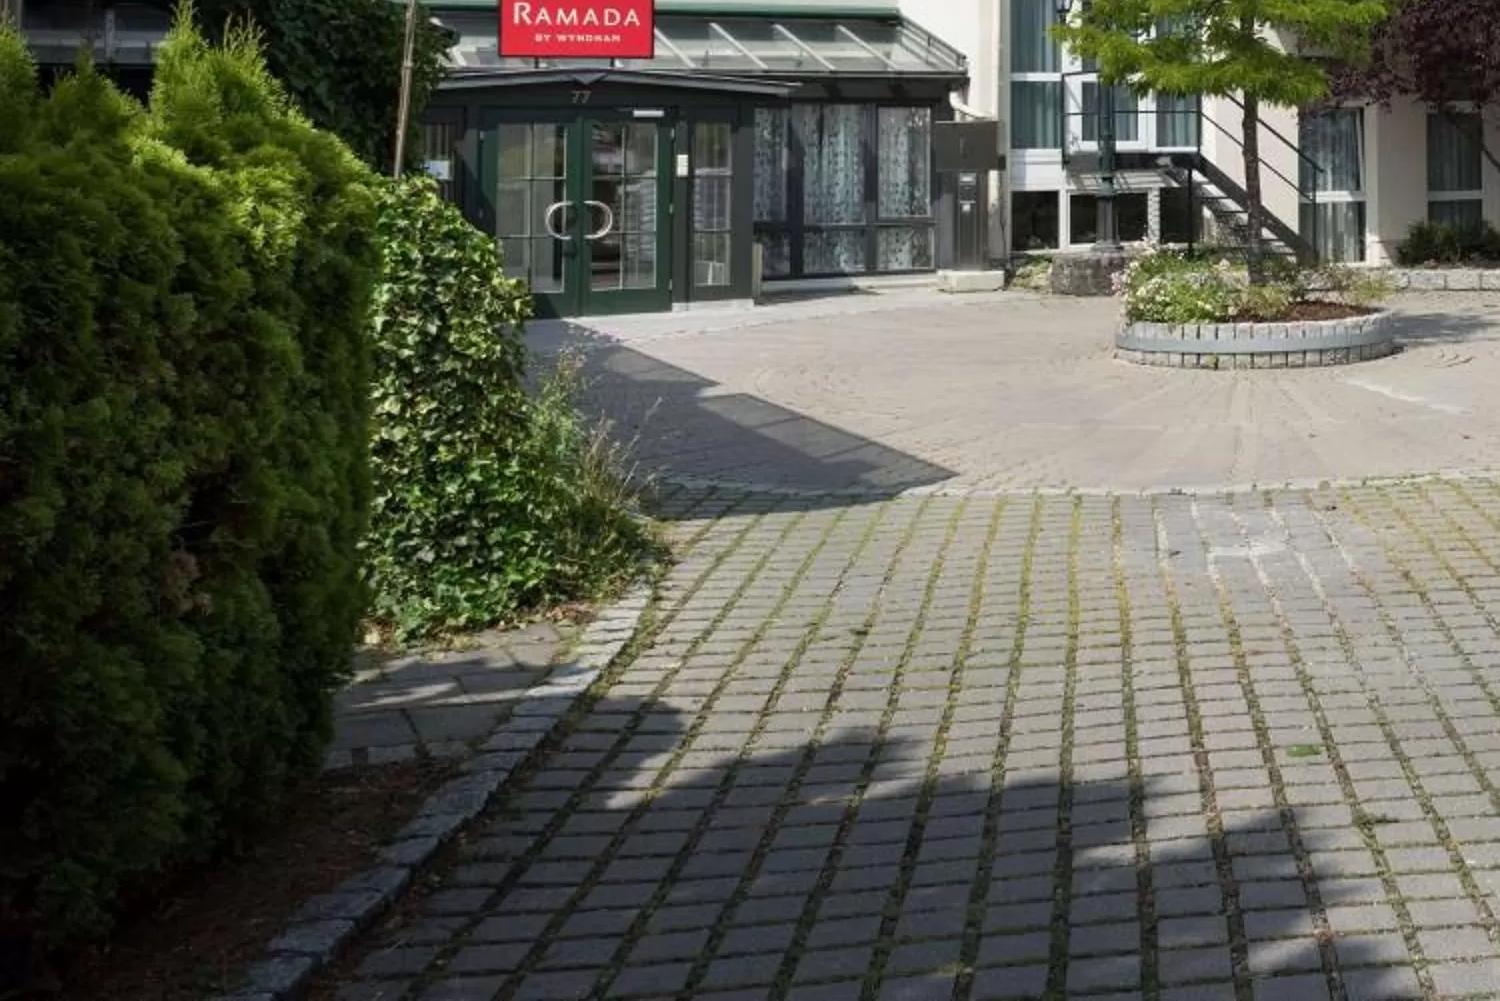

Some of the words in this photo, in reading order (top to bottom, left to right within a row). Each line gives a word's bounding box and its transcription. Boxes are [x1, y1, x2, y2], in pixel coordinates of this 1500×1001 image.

[512, 1, 642, 27] RAMADA
[534, 33, 551, 43] BY
[556, 33, 621, 43] WYNDHAM
[571, 90, 592, 104] 77
